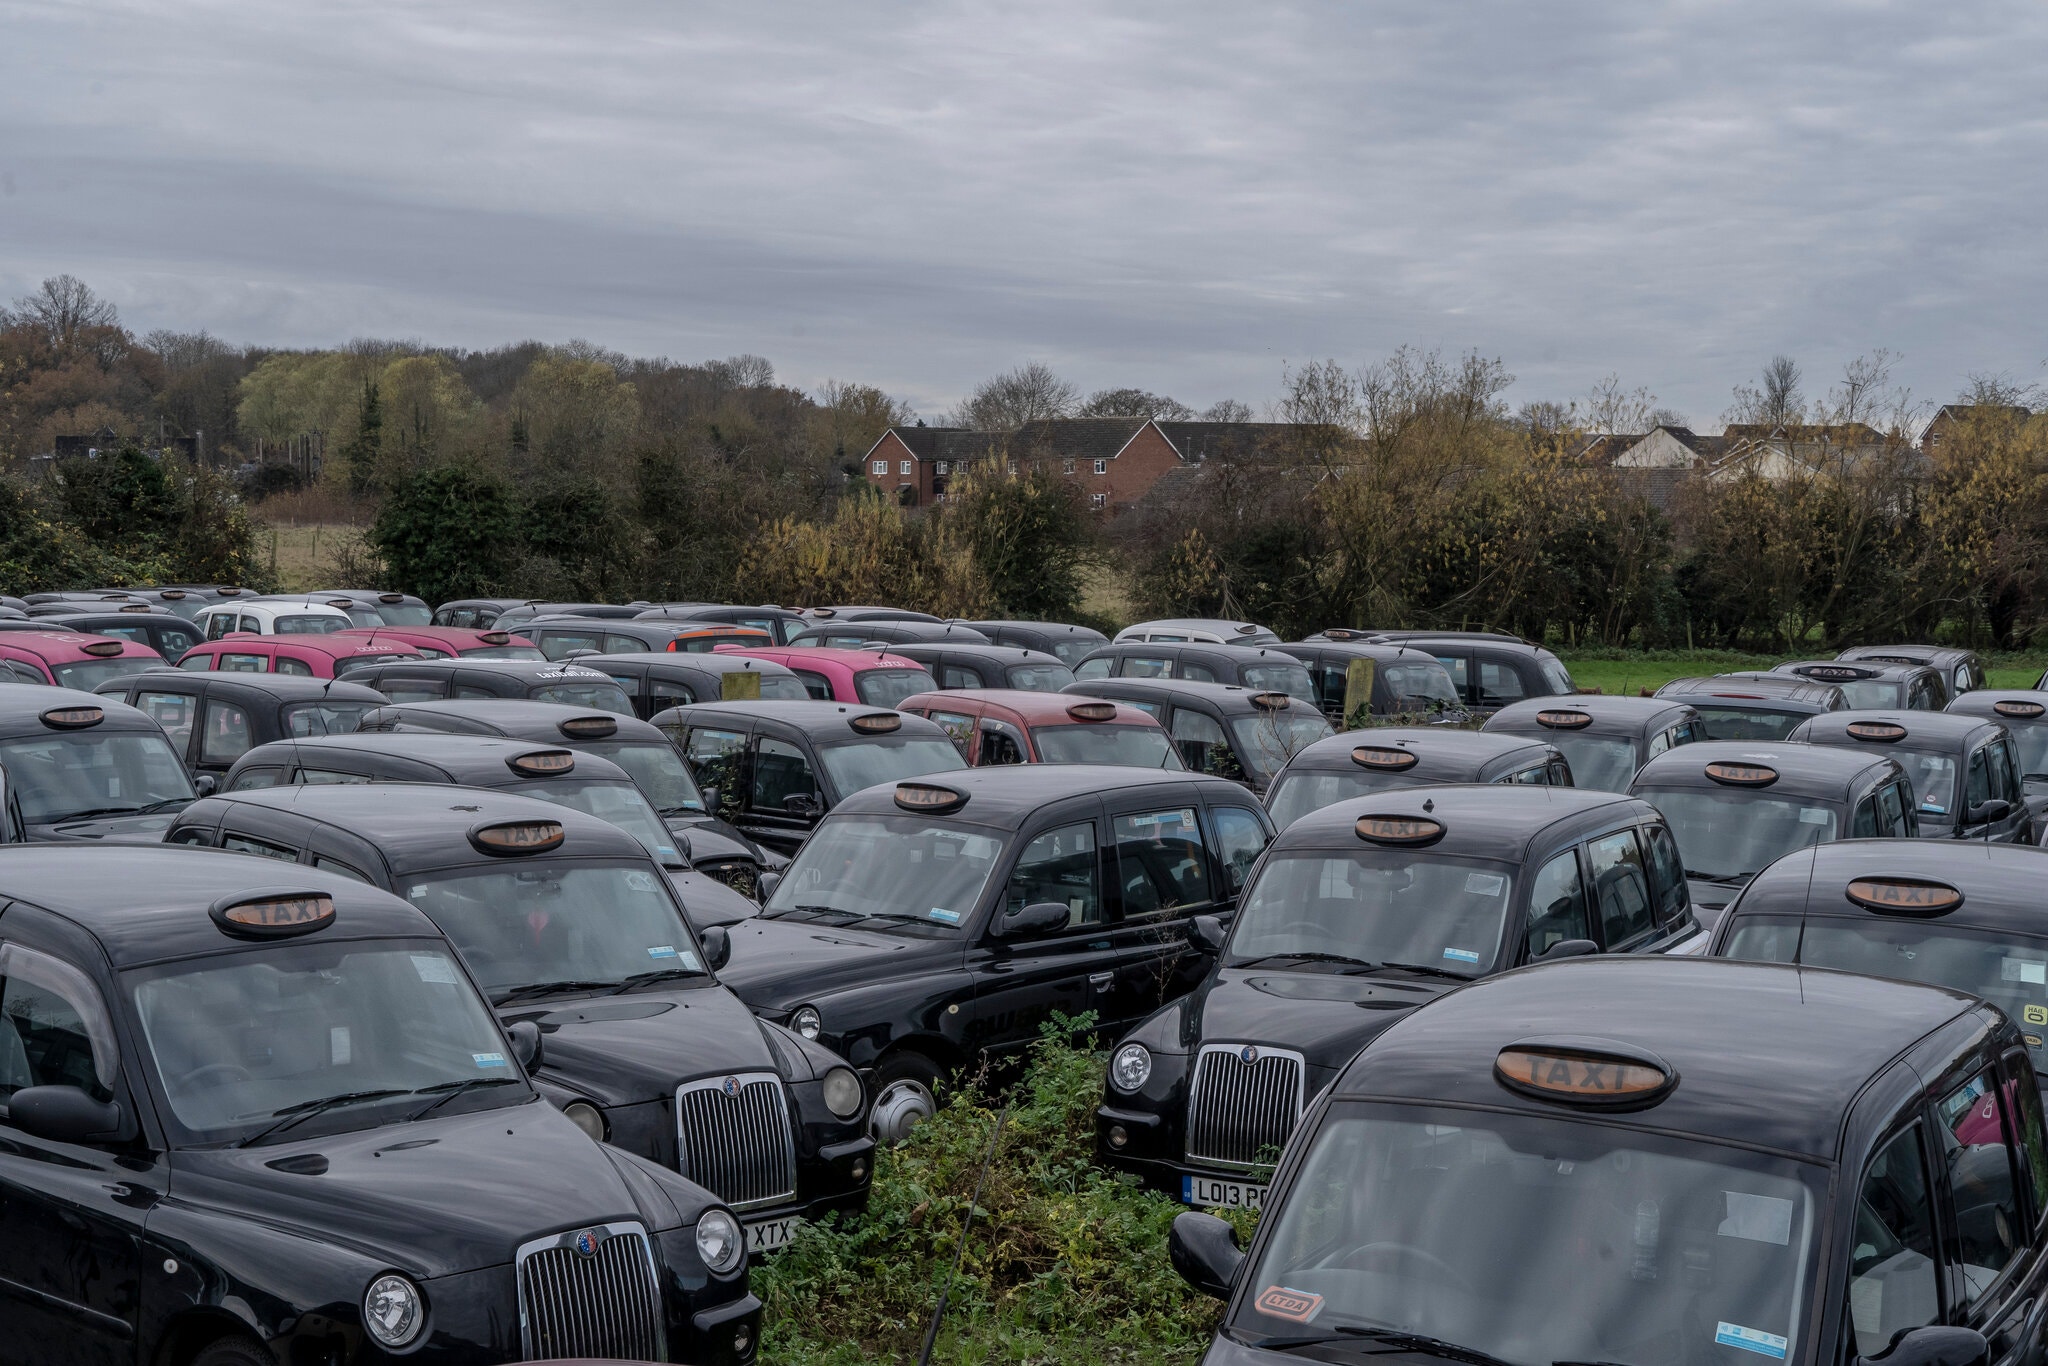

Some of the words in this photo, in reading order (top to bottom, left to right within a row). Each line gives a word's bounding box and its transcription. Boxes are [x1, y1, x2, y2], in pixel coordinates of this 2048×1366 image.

[1820, 668, 1848, 677] TAXI
[2004, 703, 2033, 712] TAXI
[62, 711, 96, 721] TAXI
[1547, 713, 1579, 723] TAXI
[1859, 726, 1892, 735] TAXI
[534, 756, 569, 768] TAXI
[1364, 751, 1400, 763] TAXI
[1719, 767, 1760, 779] TAXI
[902, 789, 940, 803] TAXI
[1370, 820, 1420, 836] TAXI
[1868, 884, 1934, 904] TAXI
[253, 898, 321, 924] TAXI
[2028, 1006, 2044, 1014] HAIL
[1526, 1054, 1626, 1091] TAXI
[1198, 1180, 1240, 1205] LO13
[754, 1220, 790, 1246] XTX
[1268, 1295, 1305, 1310] LTDA
